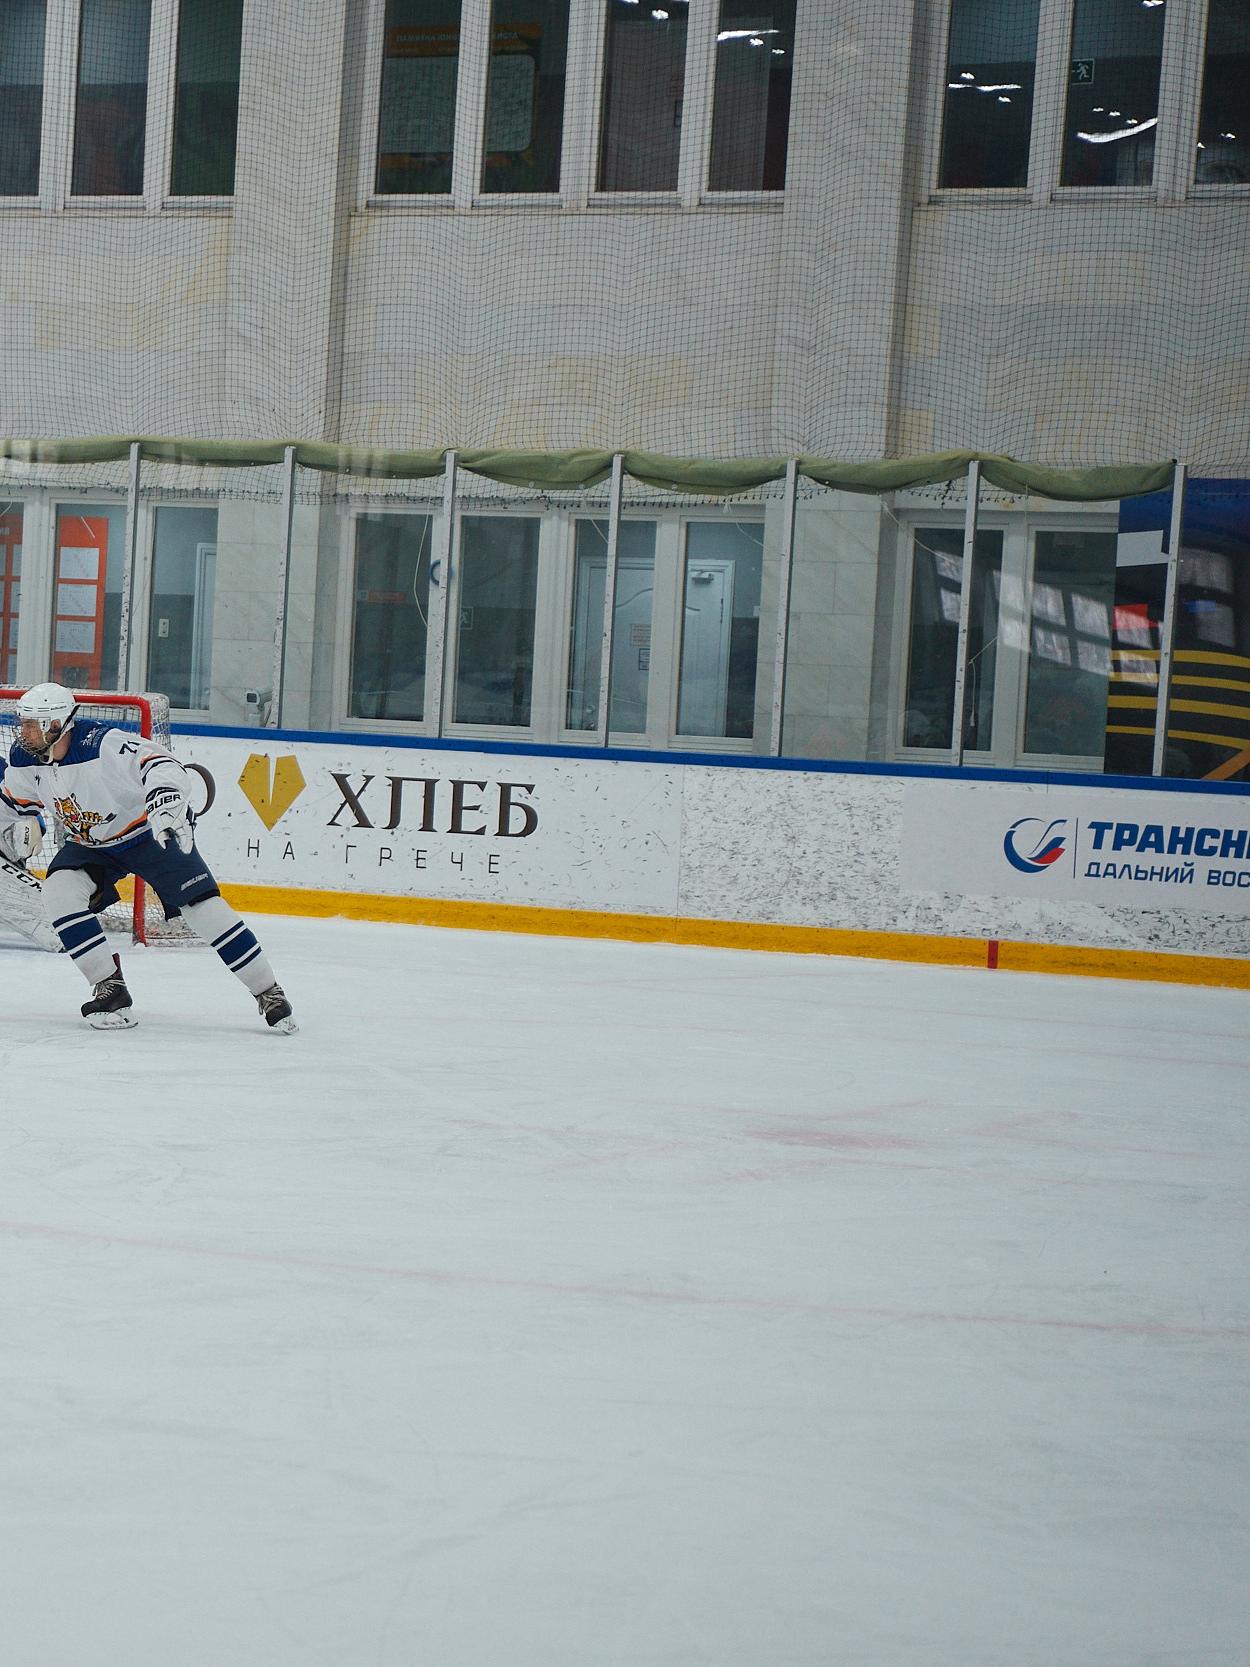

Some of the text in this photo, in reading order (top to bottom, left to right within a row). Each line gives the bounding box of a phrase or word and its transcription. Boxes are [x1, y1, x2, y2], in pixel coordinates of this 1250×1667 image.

[326, 772, 539, 838] ХЛЕБ
[247, 838, 501, 875] НА ГРЕЧЕ
[1087, 821, 1250, 860] ТРАНСН
[1084, 861, 1195, 885] ДАЛЬНИЙ
